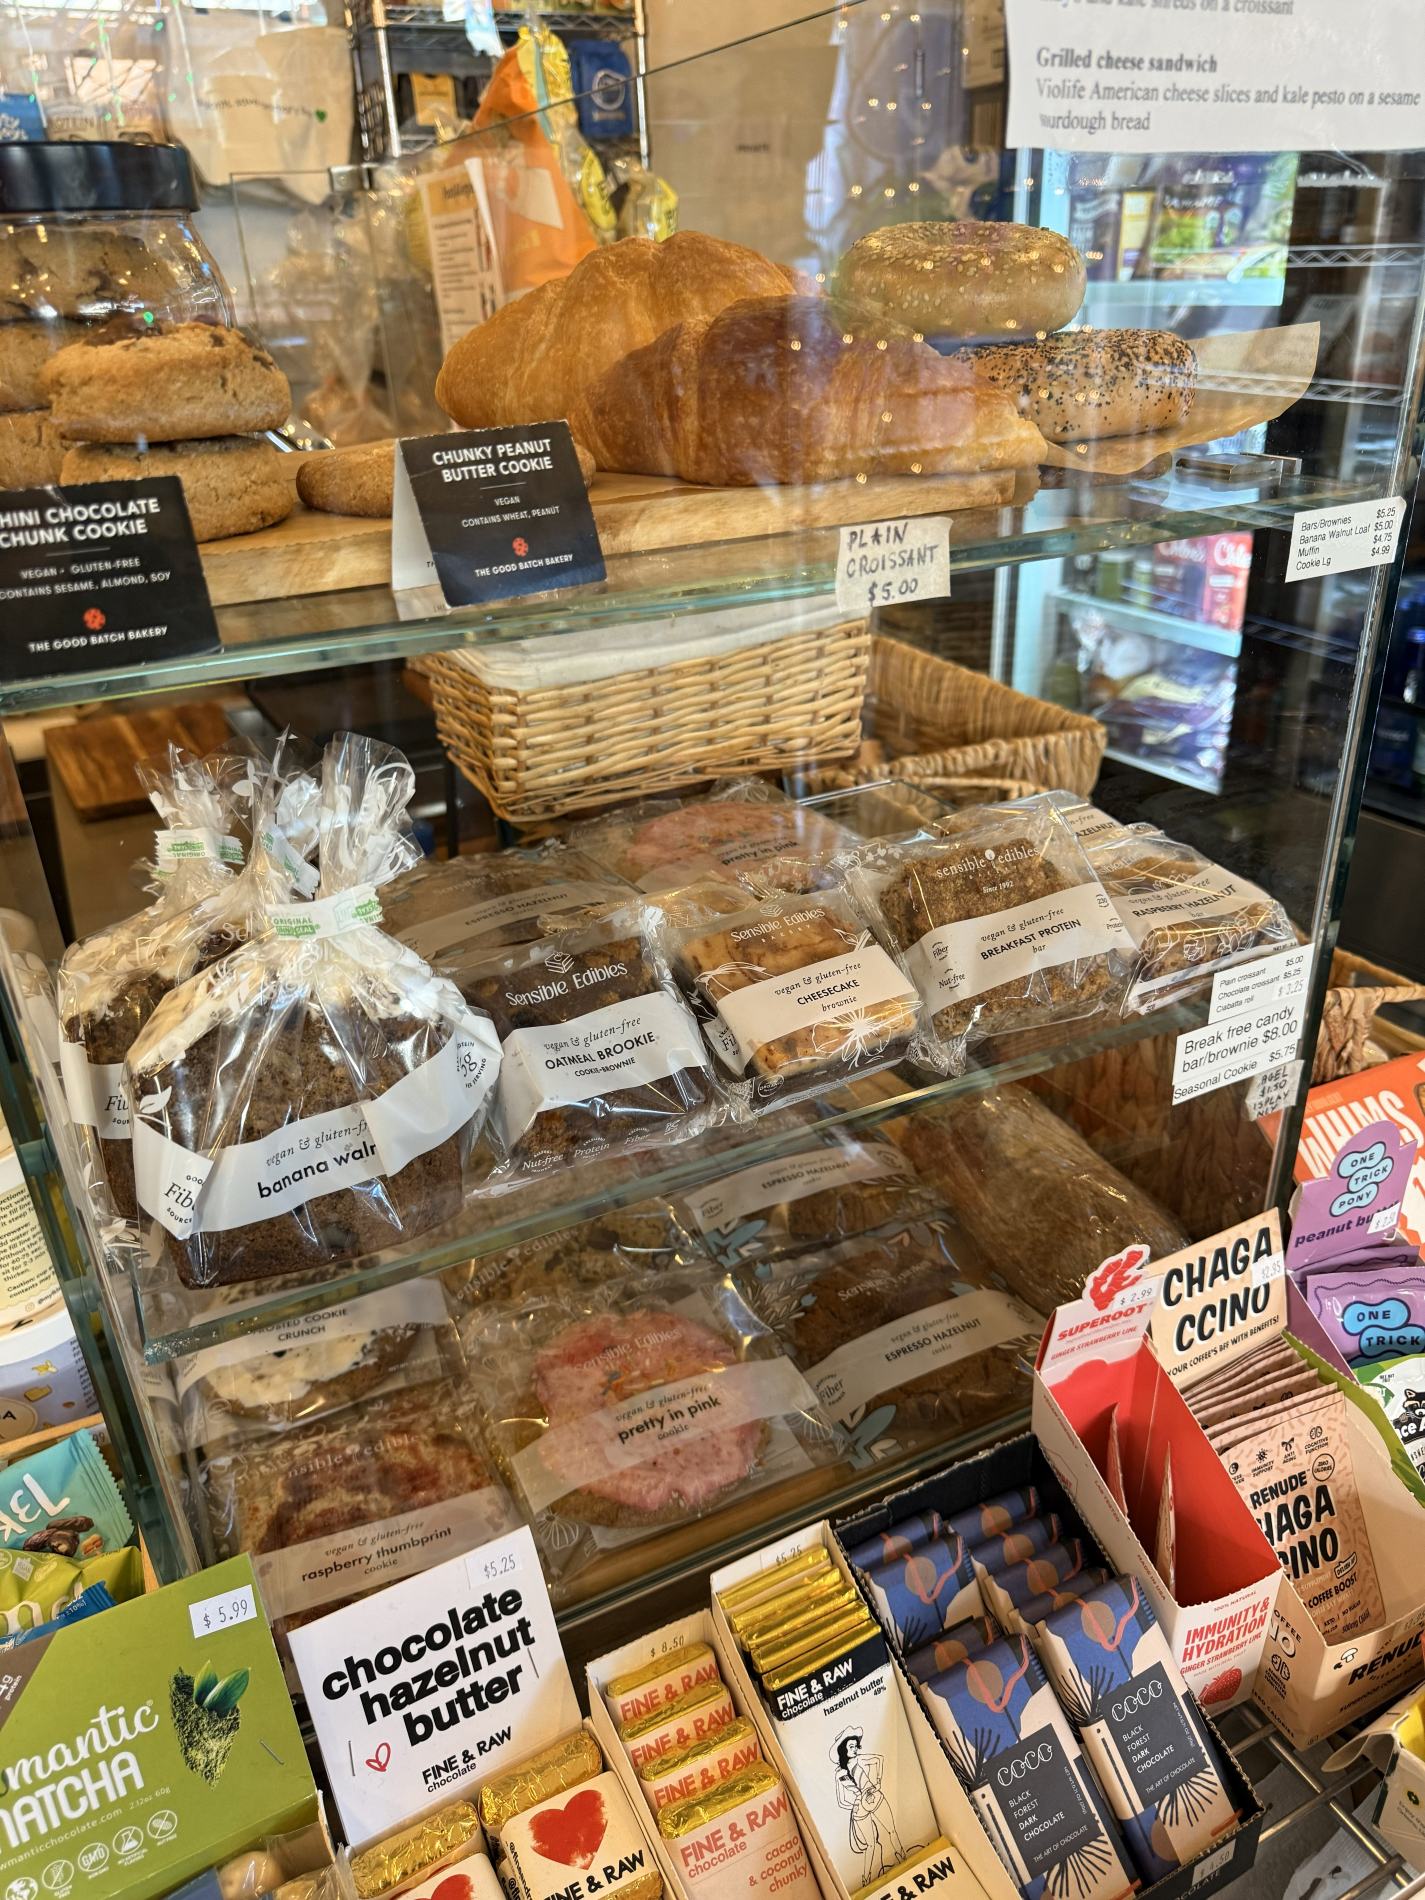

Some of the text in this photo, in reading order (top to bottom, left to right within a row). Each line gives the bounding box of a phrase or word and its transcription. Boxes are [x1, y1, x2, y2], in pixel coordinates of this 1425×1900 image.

[1037, 47, 1217, 73] Grilled cheese sandwich
[1037, 78, 1421, 109] Violife American cheese slices and kale pesto on a sesame
[1040, 110, 1151, 135] urdough bread
[432, 439, 551, 466] CHUNKY PEANUT
[441, 456, 554, 483] BUTTER COOKIE
[45, 497, 160, 524] CHOCOLATE
[494, 496, 520, 507] VEGAN
[461, 506, 560, 528] CONTAINS WHEAT, PEANUT
[1301, 507, 1396, 532] Bars/Brownies $5.25
[0, 519, 149, 549] CHUNK COOKIE
[848, 522, 908, 552] PLAIN
[1298, 533, 1392, 558] Muffin $4.75
[1299, 520, 1394, 545] Banana Walnut Loaf $5.00
[20, 557, 141, 580] VEGAN GLUTEN-FREE
[475, 554, 573, 578] THE GOOD BATCH BAKERY
[846, 544, 939, 578] CROISSANT
[1296, 545, 1390, 571] Cookie Lg $4.99
[28, 626, 168, 653] THE GOOD BATCH BAKERY
[936, 857, 987, 878] sensible
[998, 845, 1040, 865] edibles
[1132, 885, 1237, 918] RASPBERRY HAZELNUT
[730, 907, 826, 943] Sensible Edibles
[980, 919, 1082, 961] BREAKFAST PROTEIN
[1032, 943, 1048, 954] bar
[505, 961, 628, 1008] Sensible Edibles
[796, 978, 860, 1006] CHEESECAKE
[821, 996, 858, 1012] brownie
[1184, 1005, 1295, 1055] Break free candy
[544, 1031, 656, 1070] OATMEAL BROOKIE
[1182, 1020, 1299, 1073] bar/brownie $8.00
[574, 1056, 636, 1078] COOKIE-BROWNIE
[1174, 1043, 1296, 1099] Seasonal Cookie $5.75
[265, 1144, 295, 1166] vegan
[298, 1136, 312, 1151] &
[1350, 1152, 1376, 1168] ONE
[257, 1160, 330, 1199] banana
[1353, 1164, 1390, 1186] TRICK
[1338, 1190, 1373, 1209] PONY
[1163, 1226, 1272, 1307] CHAGA
[304, 1308, 350, 1326] COOKIE
[1057, 1304, 1148, 1342] SUPEROOT
[1175, 1282, 1270, 1352] CCINO
[1356, 1309, 1391, 1322] ONE
[278, 1324, 326, 1342] CRUNCH
[884, 1318, 982, 1363] ESPRESSO HAZELNUT
[1366, 1336, 1421, 1347] TRICK
[616, 1395, 722, 1446] pretty in pink
[656, 1424, 690, 1442] cookie
[1250, 1470, 1308, 1510] RENUDE
[301, 1528, 452, 1582] raspberry thumbprint
[364, 1558, 399, 1575] cookie
[484, 1554, 516, 1580] $5.25
[1308, 1588, 1333, 1609] COFFEE
[1334, 1572, 1358, 1595] BOOST
[322, 1588, 522, 1701] chocolate
[1182, 1611, 1268, 1664] HYDRATION
[359, 1616, 535, 1726] hazelnut
[776, 1659, 853, 1711] FINE & RAW
[402, 1664, 523, 1747] butter
[620, 1663, 720, 1722] FINE & RAW
[782, 1692, 824, 1718] chocolate
[822, 1676, 884, 1717] hazelnut butter
[1111, 1679, 1164, 1722] COCO
[630, 1702, 733, 1769] FINE & RAW
[1122, 1724, 1144, 1742] BLACK
[1126, 1734, 1151, 1753] FOREST
[422, 1726, 512, 1786] FINE & RAW
[998, 1742, 1054, 1787] COCO
[1131, 1747, 1150, 1764] DARK
[1136, 1744, 1175, 1774] CHOCOLATE
[427, 1762, 477, 1793] chocolate
[654, 1742, 760, 1809] FINE & RAW
[1008, 1790, 1032, 1808] BLACK
[1012, 1800, 1040, 1820] FOREST
[680, 1792, 788, 1868] FINE & RAW
[1018, 1814, 1038, 1831] DARK
[1024, 1810, 1066, 1842] CHOCOLATE
[688, 1840, 748, 1879] chocolate
[765, 1835, 799, 1863] cacao
[749, 1848, 804, 1887] & coconut
[768, 1864, 808, 1893] chunky
